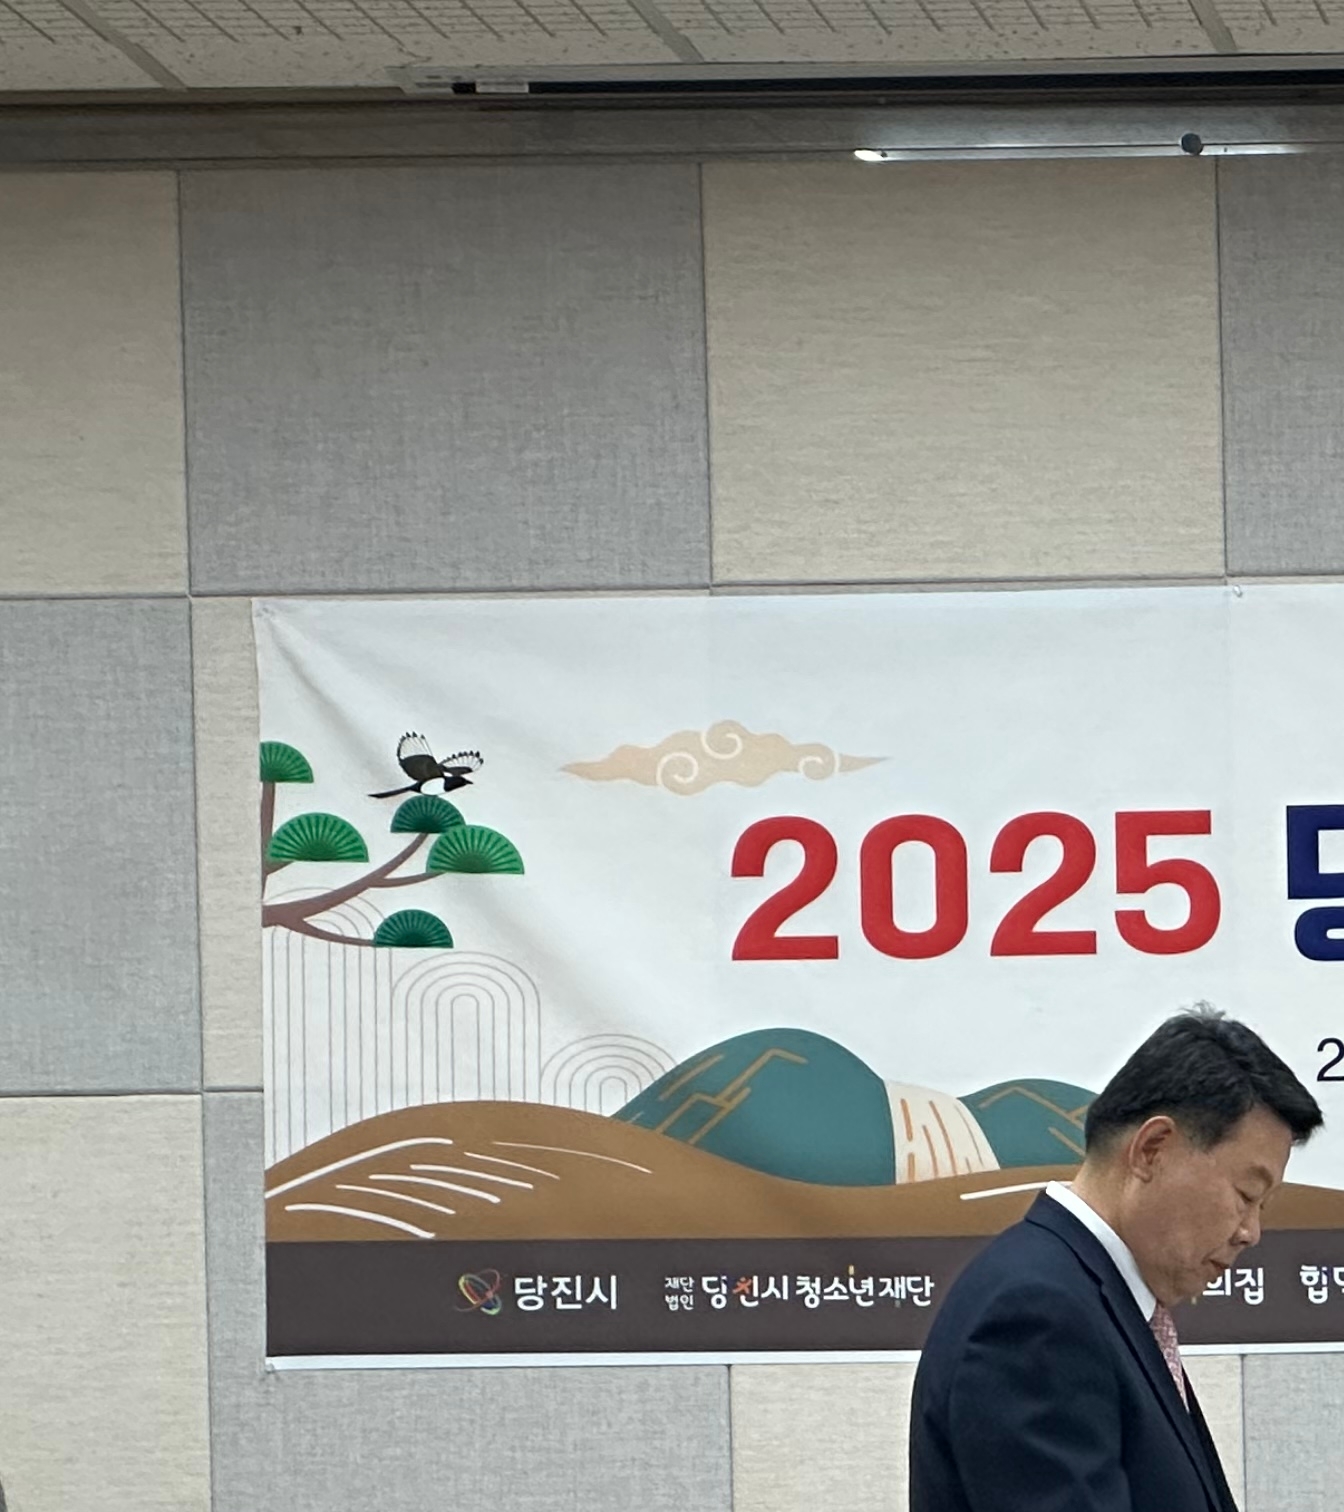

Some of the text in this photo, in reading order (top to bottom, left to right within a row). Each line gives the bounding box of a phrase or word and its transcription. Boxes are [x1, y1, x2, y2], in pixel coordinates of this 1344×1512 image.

[731, 809, 1221, 961] 2025
[514, 1274, 617, 1311] 당진시
[664, 1276, 695, 1292] 재단
[664, 1293, 695, 1311] 법인
